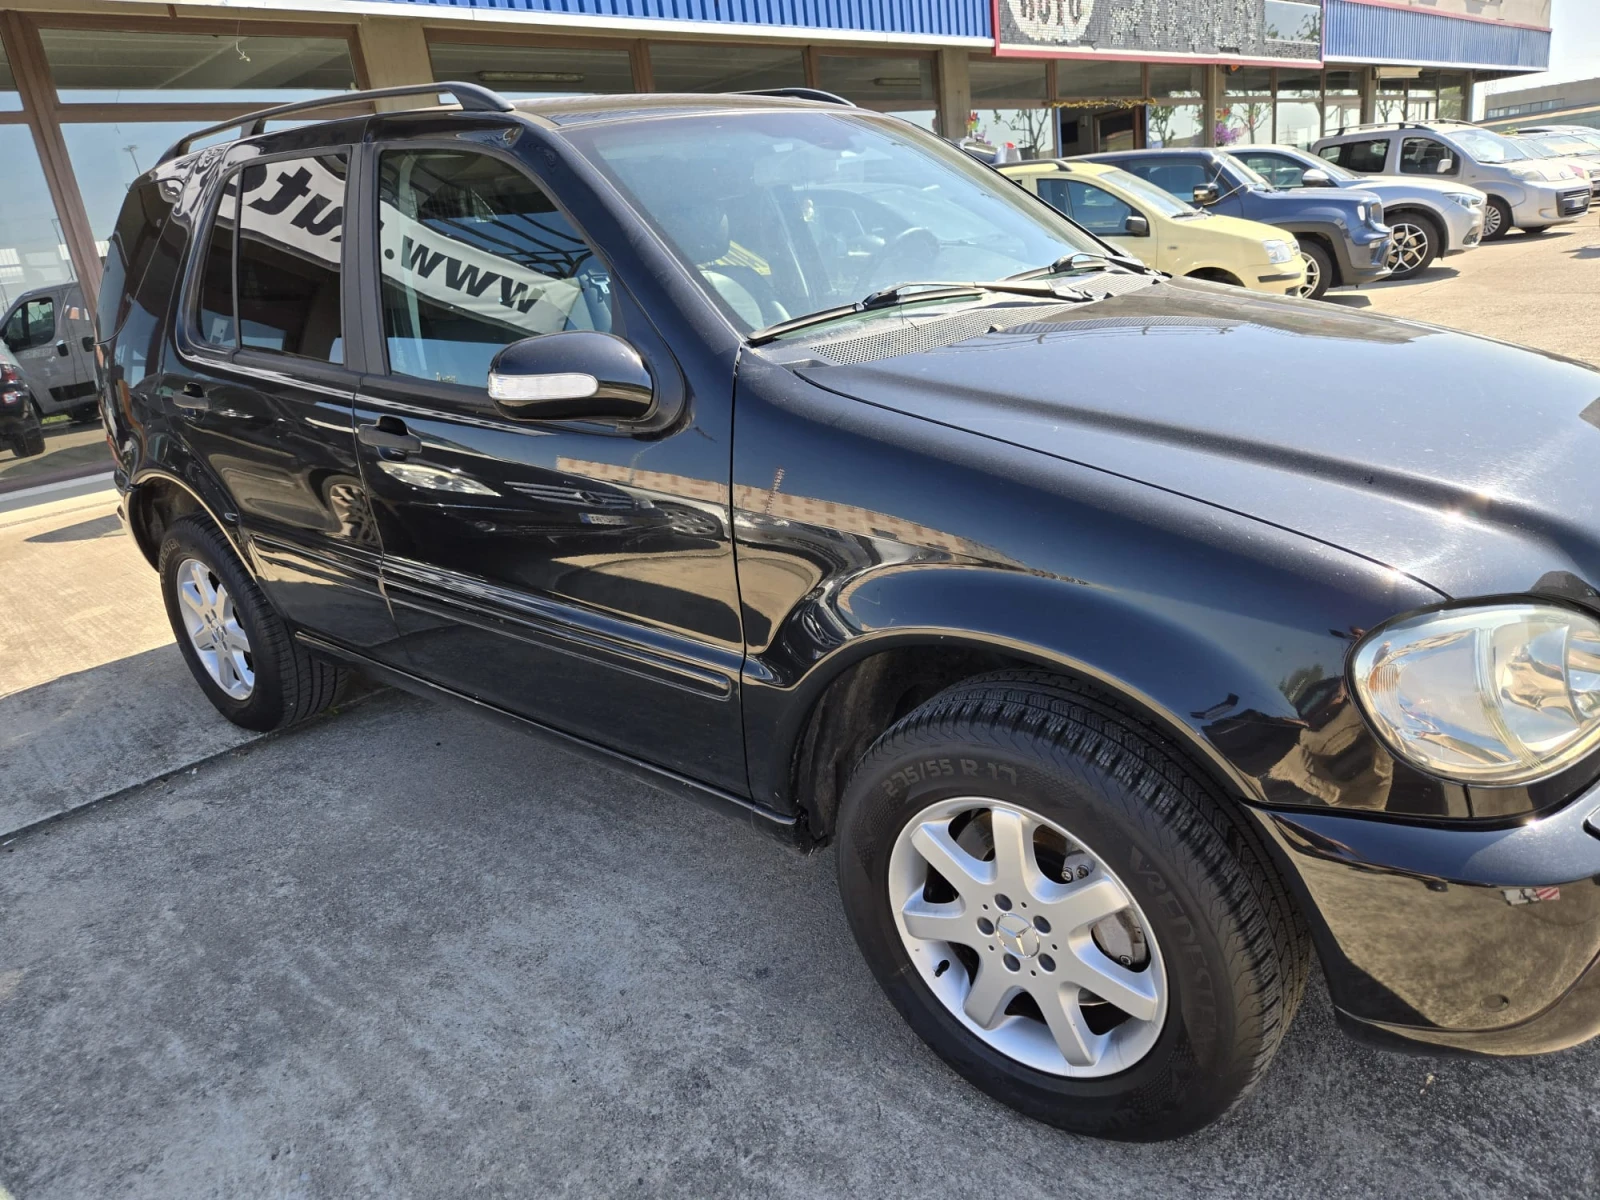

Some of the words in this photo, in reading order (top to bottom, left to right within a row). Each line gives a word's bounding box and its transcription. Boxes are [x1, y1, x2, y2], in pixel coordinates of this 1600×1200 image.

[881, 759, 954, 797] 275/55
[960, 758, 979, 777] R
[987, 761, 1018, 787] 17
